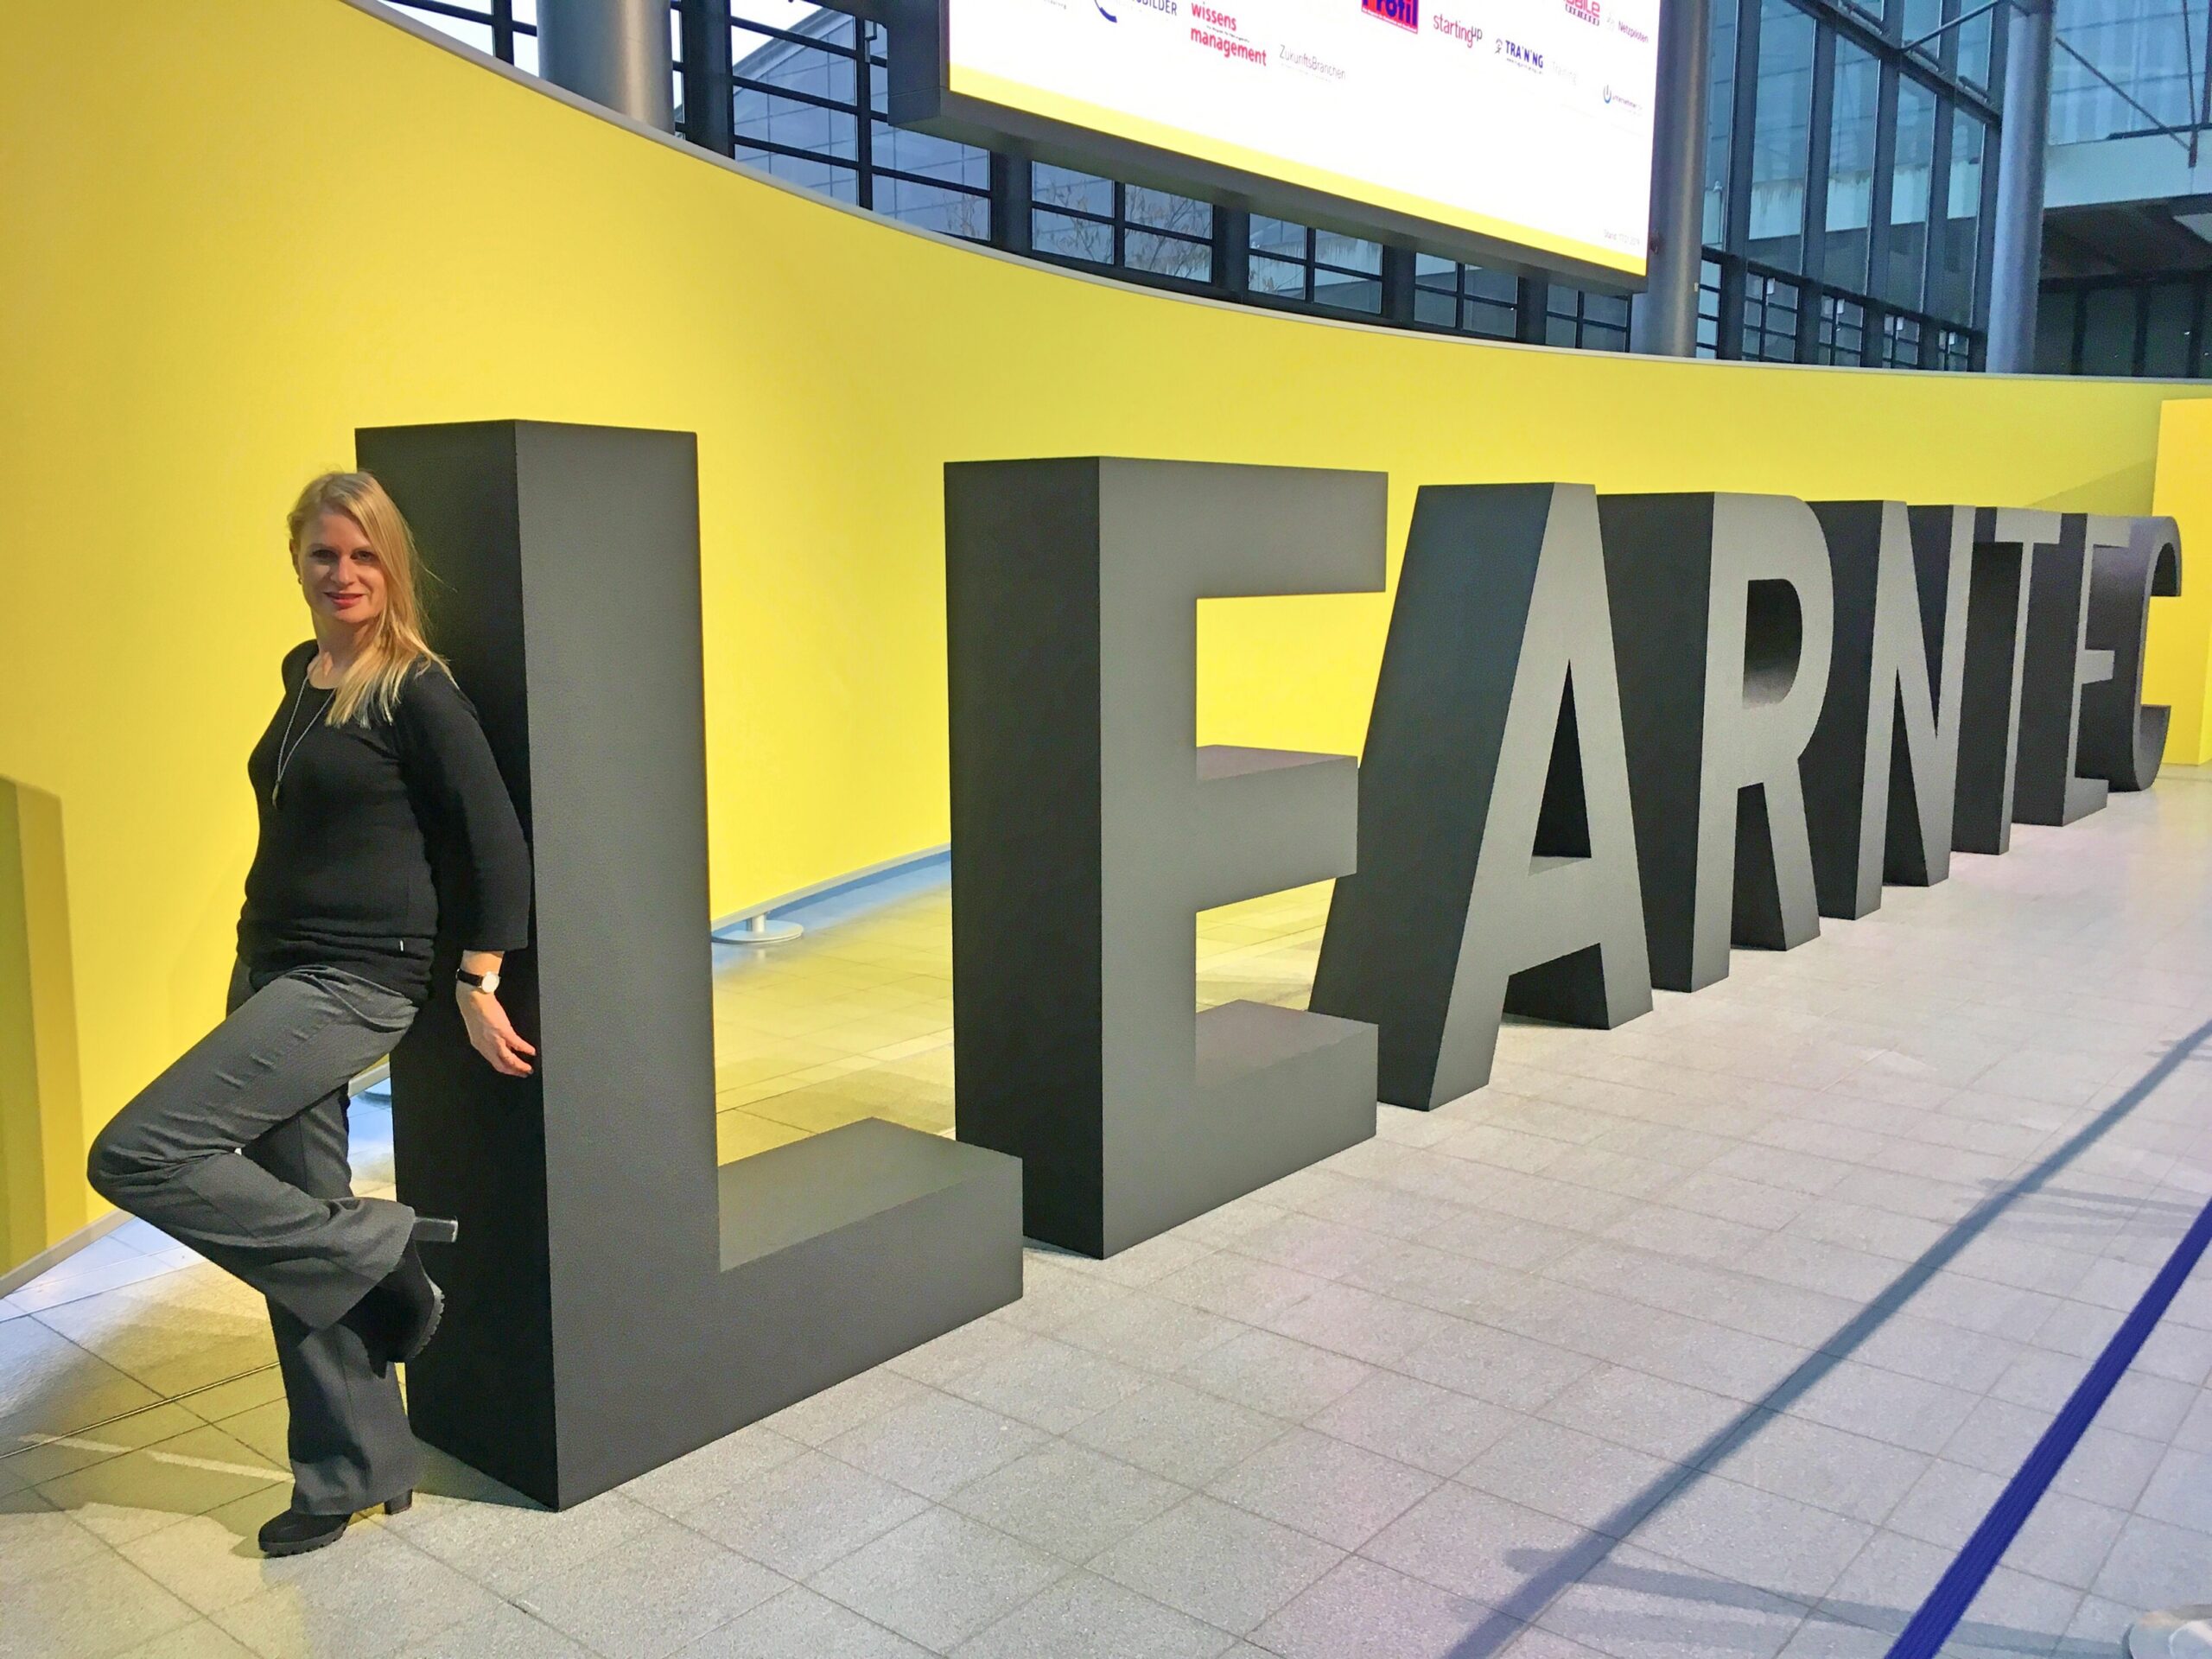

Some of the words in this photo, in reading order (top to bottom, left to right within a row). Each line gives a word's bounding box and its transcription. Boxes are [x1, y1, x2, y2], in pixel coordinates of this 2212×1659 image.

[1192, 2, 1236, 31] wissens
[1363, 0, 1418, 26] rofil
[1191, 28, 1267, 66] management
[1280, 44, 1345, 79] ZukunftsBranchen
[355, 421, 2183, 1510] LEARNTEC
